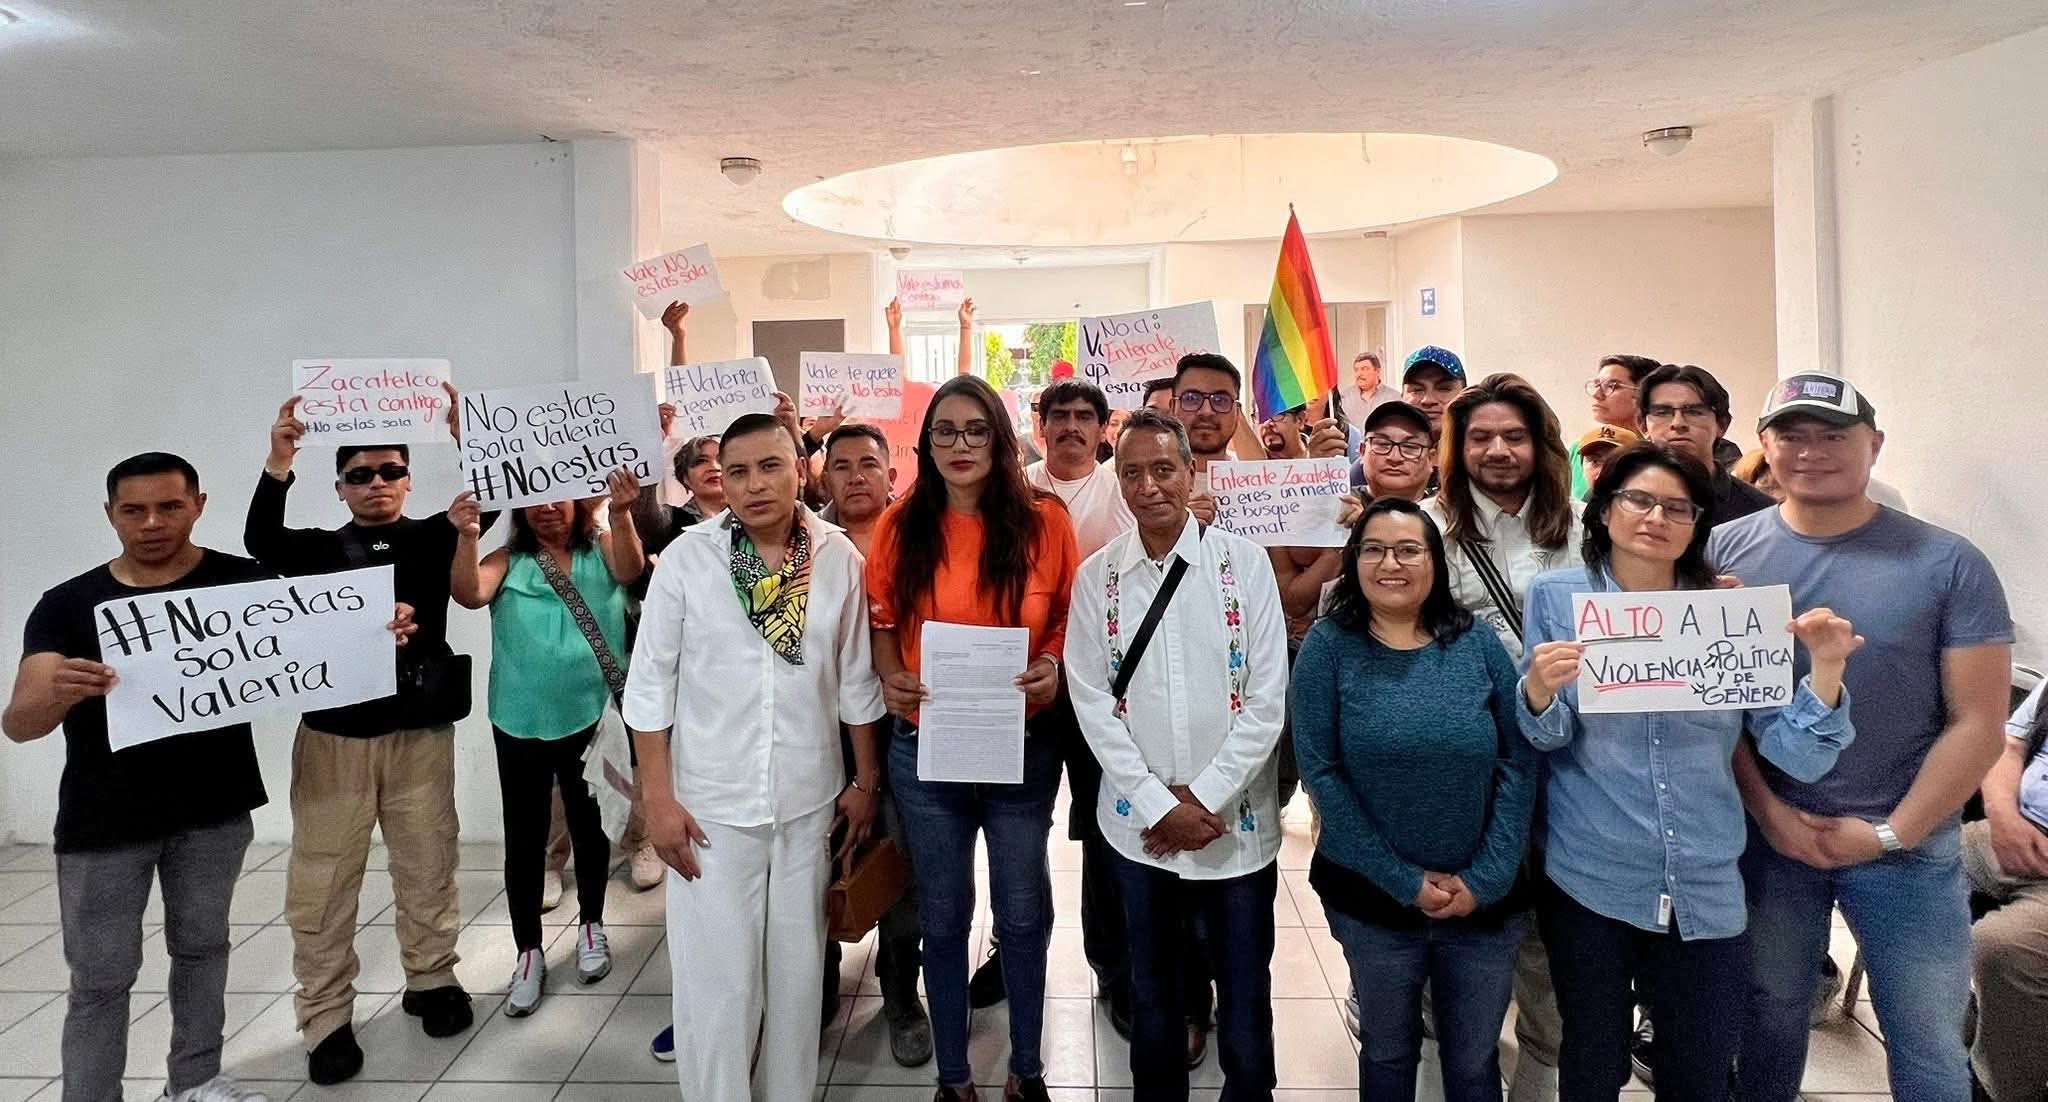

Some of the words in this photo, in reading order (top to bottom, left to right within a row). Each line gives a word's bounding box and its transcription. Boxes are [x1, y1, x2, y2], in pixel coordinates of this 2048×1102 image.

[624, 264, 657, 282] Vale
[664, 253, 689, 274] NO
[638, 276, 679, 297] estas
[680, 264, 708, 284] sola
[1101, 318, 1130, 338] No
[1104, 333, 1176, 364] Enterate
[298, 365, 439, 391] Zacatelco
[666, 365, 758, 395] #Valeria
[806, 362, 838, 379] Vale
[848, 365, 862, 380] te
[751, 383, 771, 399] en
[806, 383, 845, 393] mos
[851, 383, 870, 397] No
[303, 394, 369, 417] esta
[377, 391, 443, 424] contigo
[465, 393, 517, 433] No
[526, 389, 615, 427] estas
[336, 417, 376, 432] estas
[382, 418, 412, 428] sola
[1210, 465, 1277, 491] Enterate
[1280, 463, 1347, 486] Zacatelco
[1238, 490, 1272, 505] eres
[1280, 486, 1298, 499] un
[1243, 501, 1300, 525] busque
[1579, 600, 1663, 638] ALTO
[1680, 604, 1701, 636] A
[1721, 605, 1762, 637] LA
[1585, 655, 1705, 684] VIOLENCIA
[1734, 672, 1755, 684] DE
[152, 661, 333, 723] Valeria
